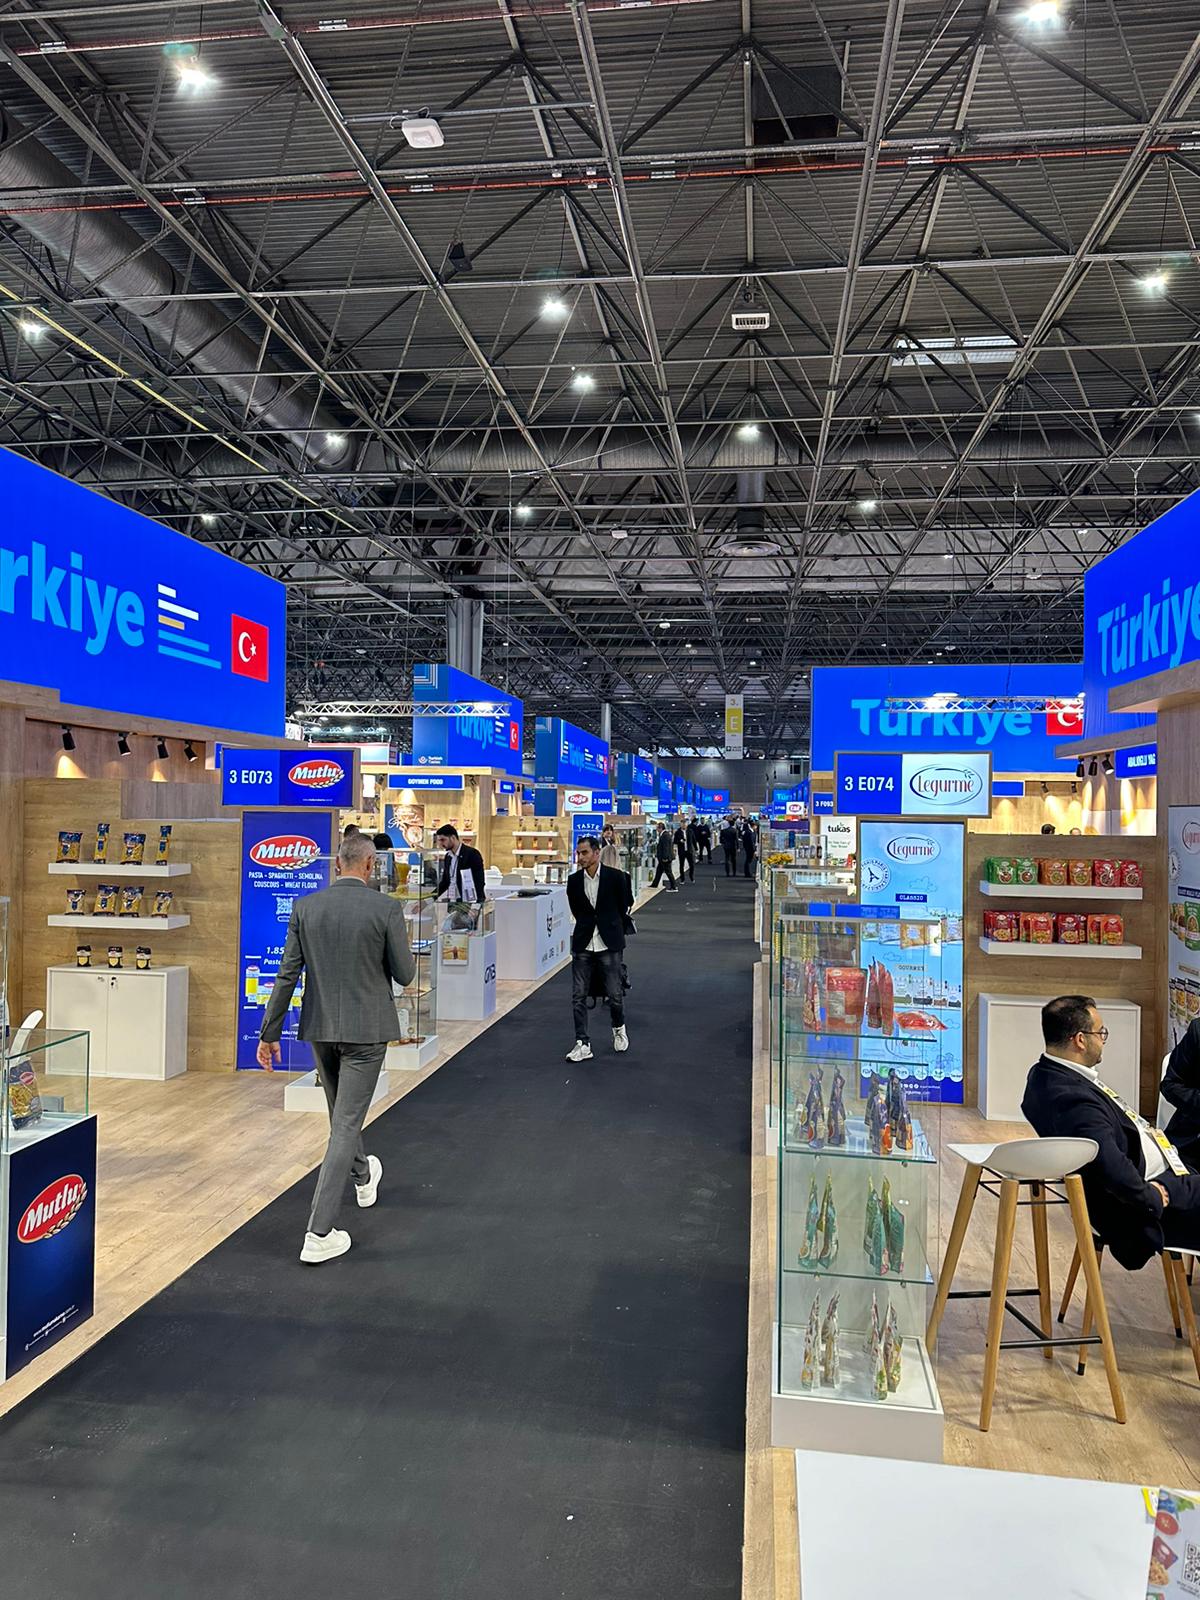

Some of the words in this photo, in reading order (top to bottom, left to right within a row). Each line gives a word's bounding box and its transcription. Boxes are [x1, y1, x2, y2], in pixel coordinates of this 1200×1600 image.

[730, 716, 739, 730] E
[851, 697, 1033, 745] Türkiye
[229, 770, 237, 784] 3
[241, 770, 273, 784] E073
[293, 764, 337, 780] Mutlu
[844, 776, 854, 791] 3
[858, 776, 895, 791] E074
[256, 842, 315, 860] Mutlu
[248, 871, 264, 879] PASTA
[253, 880, 280, 888] COUSCOUS
[23, 1183, 79, 1237] Mutlu
